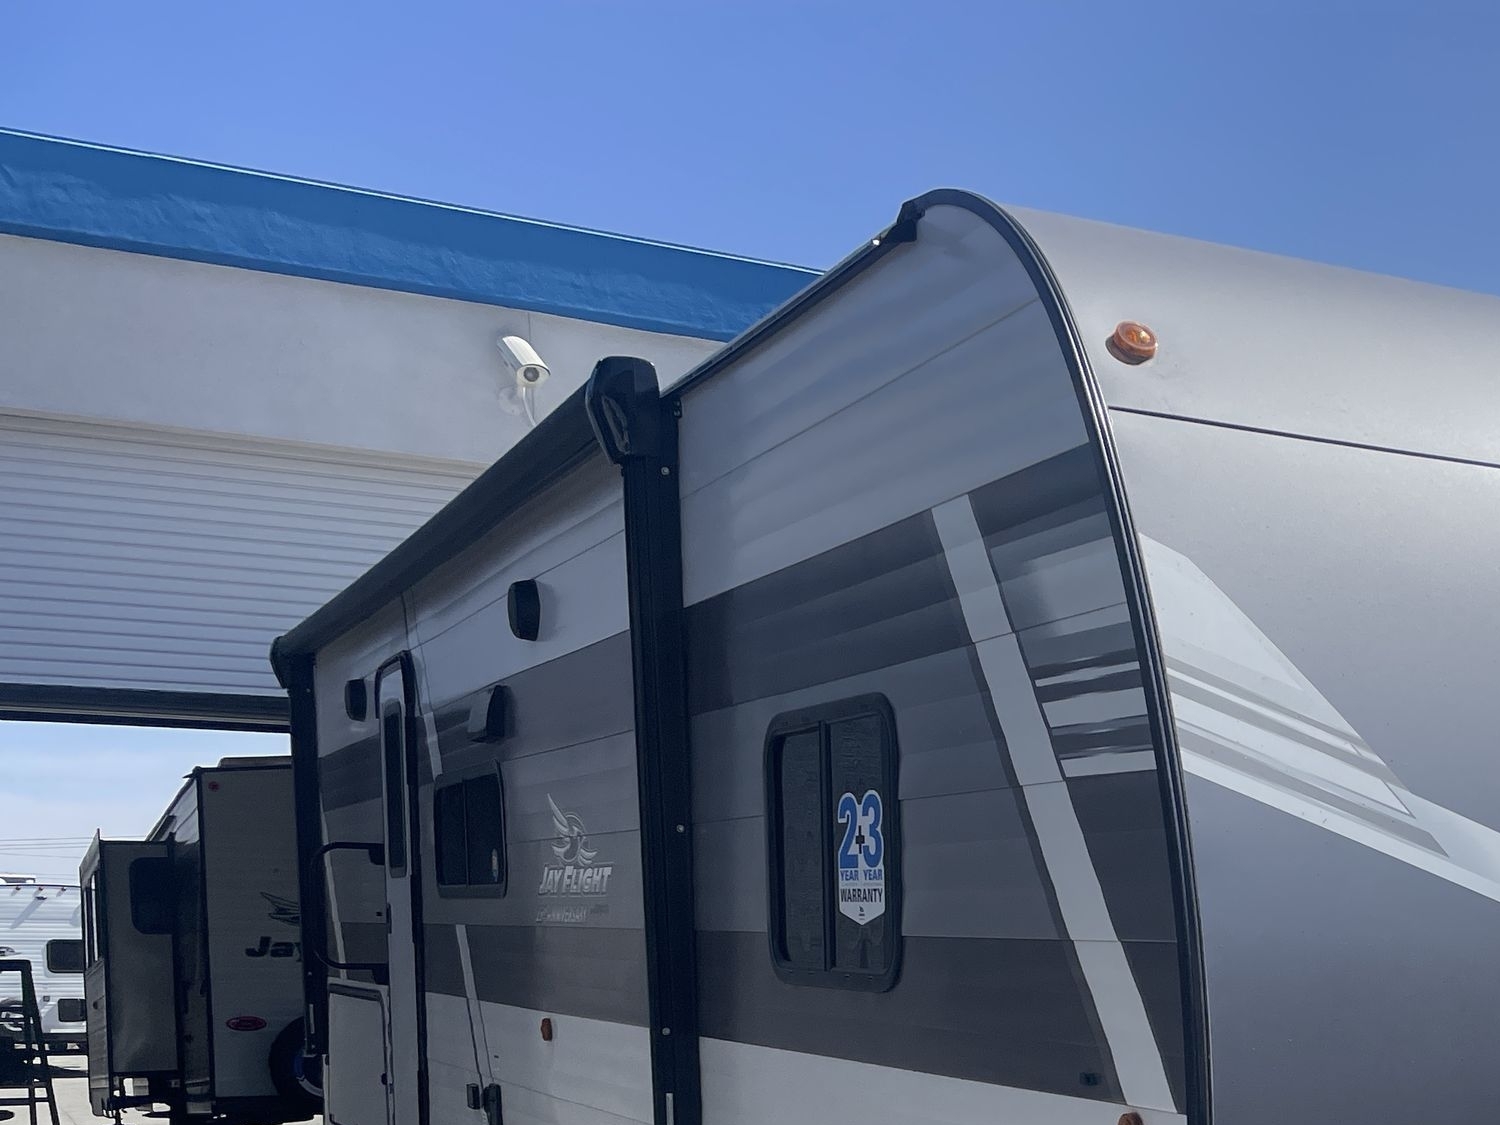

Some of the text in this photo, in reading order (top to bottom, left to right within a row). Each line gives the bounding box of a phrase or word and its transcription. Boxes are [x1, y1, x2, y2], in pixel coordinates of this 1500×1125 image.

[538, 865, 613, 895] JAY FLIGHT
[840, 869, 883, 881] YEAR YEAR
[840, 888, 883, 903] WARRANTY
